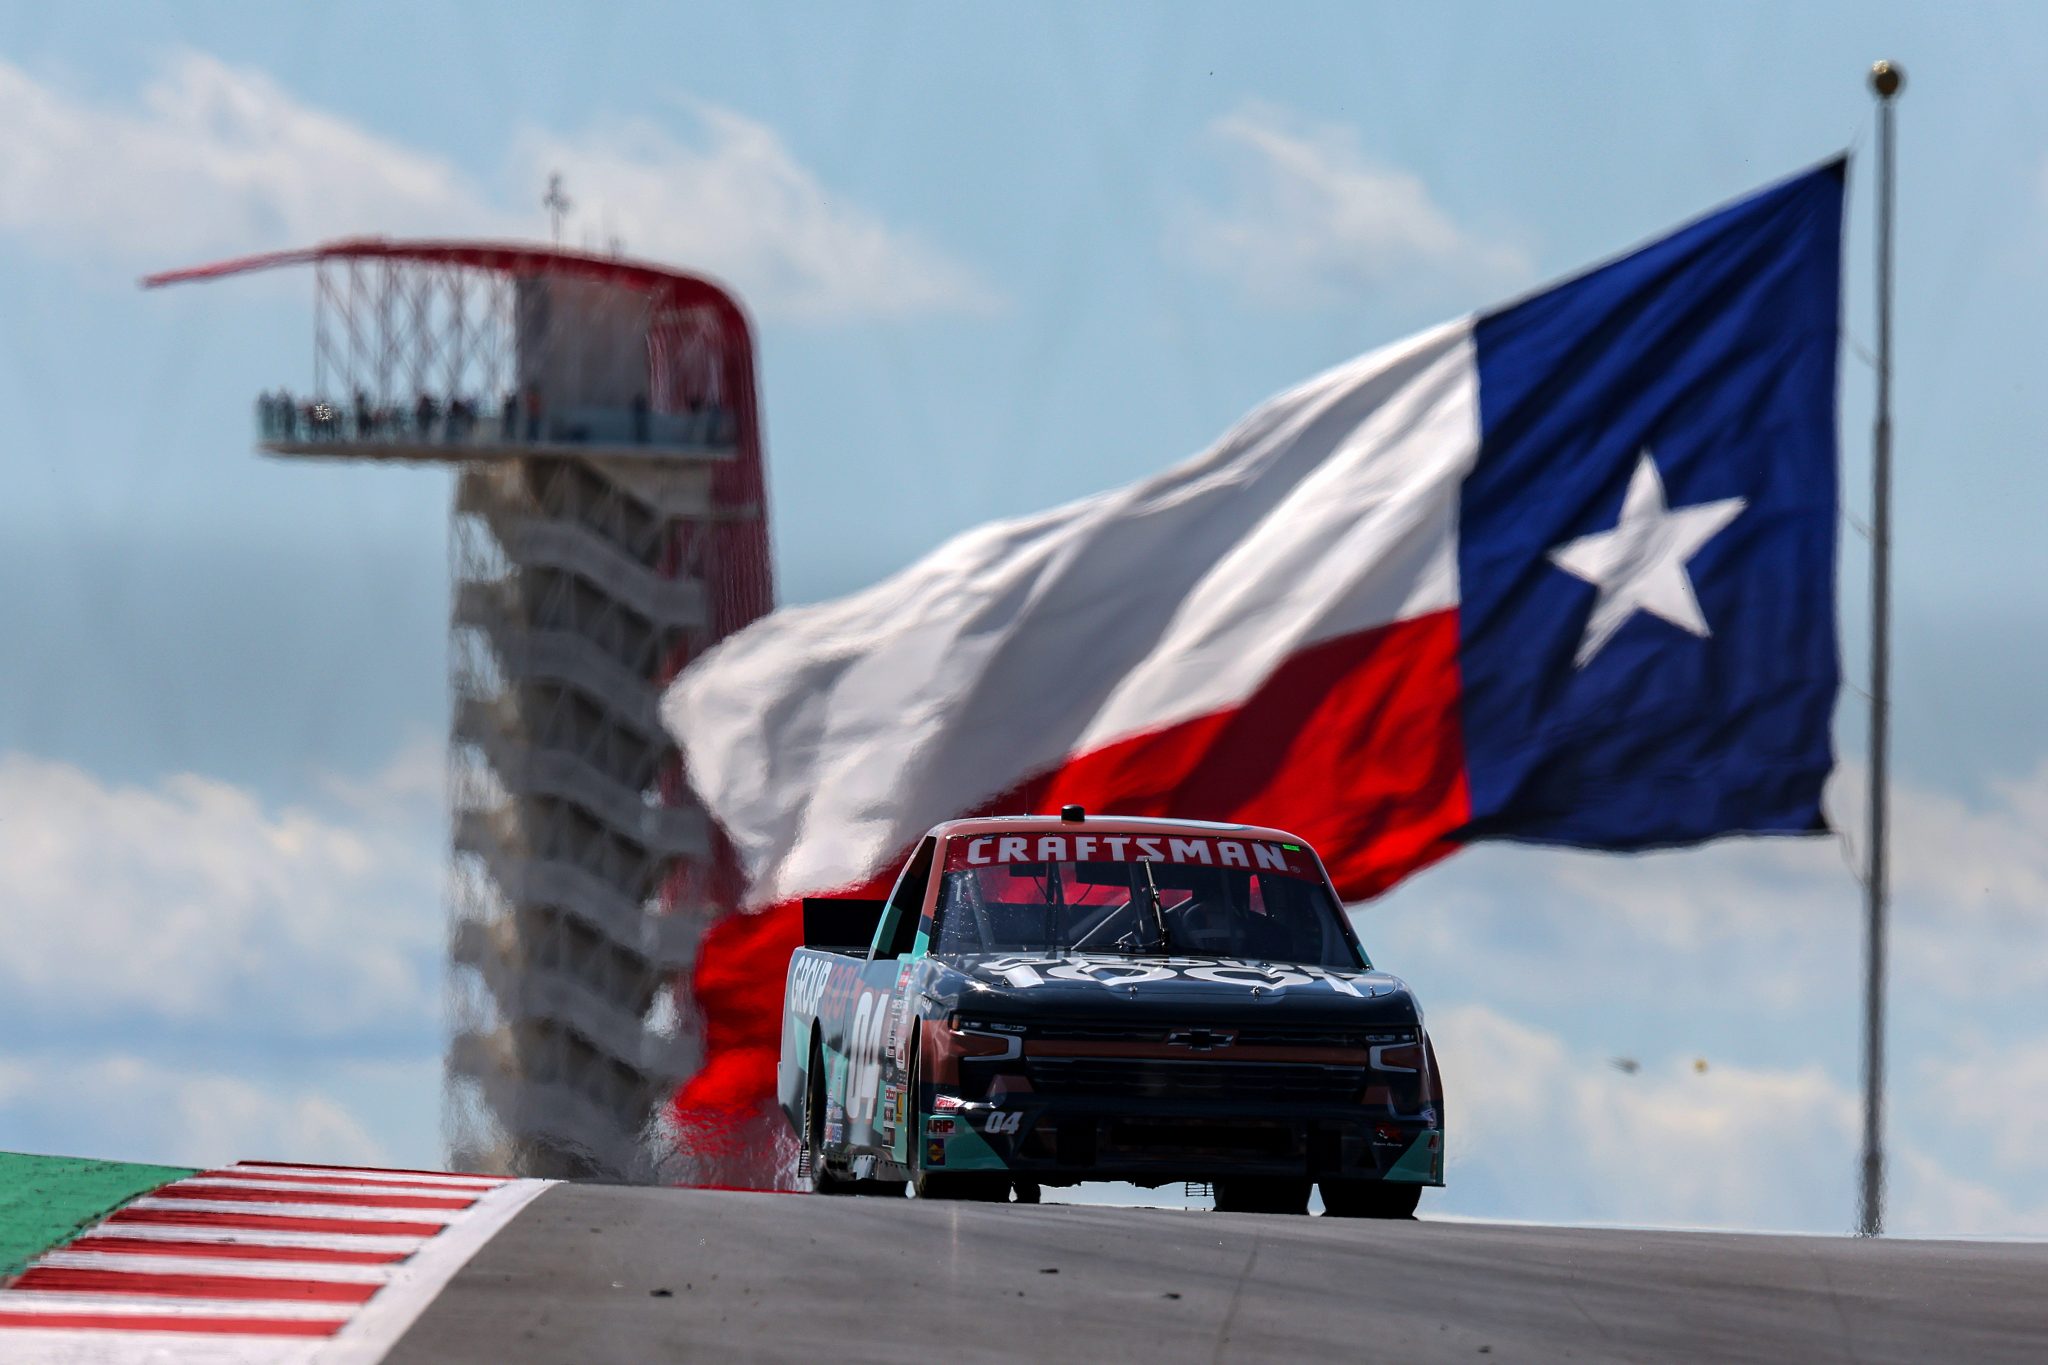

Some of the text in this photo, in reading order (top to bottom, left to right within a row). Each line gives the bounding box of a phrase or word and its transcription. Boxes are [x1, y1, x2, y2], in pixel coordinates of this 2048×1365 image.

[967, 836, 1288, 872] CRAFTSMAN
[791, 955, 833, 1016] GROUP
[846, 988, 890, 1122] 04
[927, 1119, 955, 1134] ARP
[984, 1111, 1023, 1135] 04
